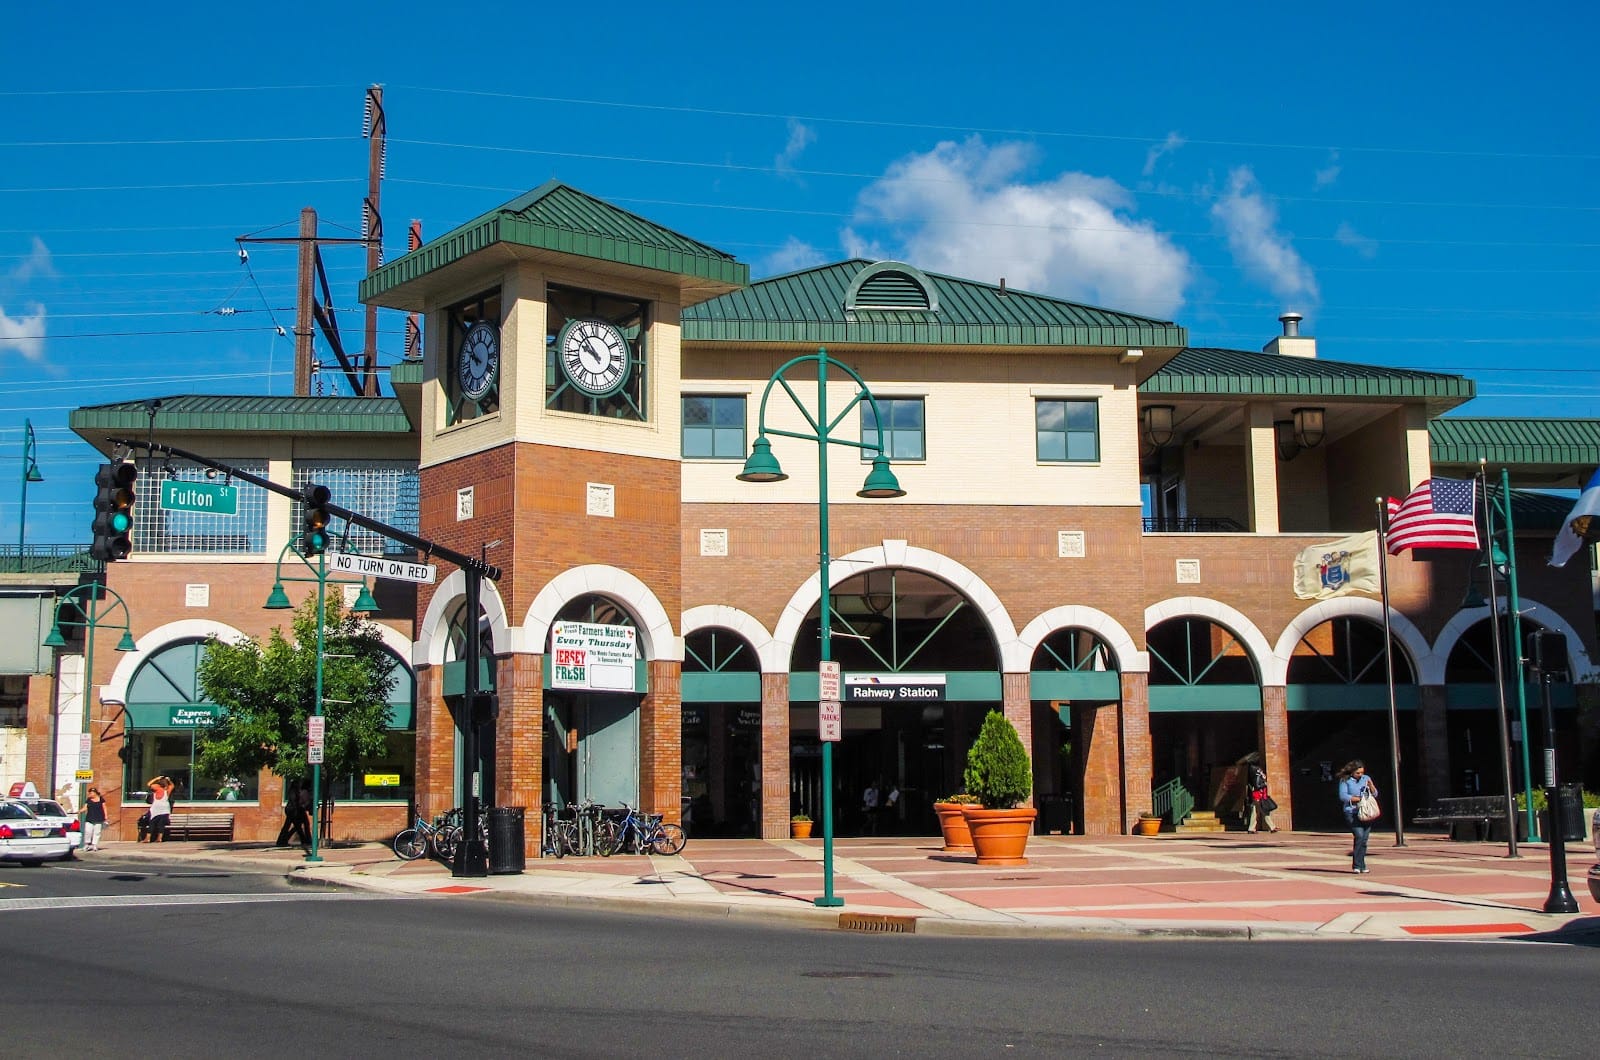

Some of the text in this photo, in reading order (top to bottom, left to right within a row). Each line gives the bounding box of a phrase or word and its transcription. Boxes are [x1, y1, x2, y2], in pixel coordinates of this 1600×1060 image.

[170, 487, 228, 507] Fulton St
[336, 556, 428, 579] NO TURN ON RED
[578, 625, 603, 636] Farmers
[605, 627, 626, 638] Market
[557, 636, 631, 649] Every Thursday
[556, 649, 586, 665] JERSEY
[555, 666, 586, 680] FRESH
[853, 687, 938, 699] Rahway Station
[177, 709, 211, 718] Express
